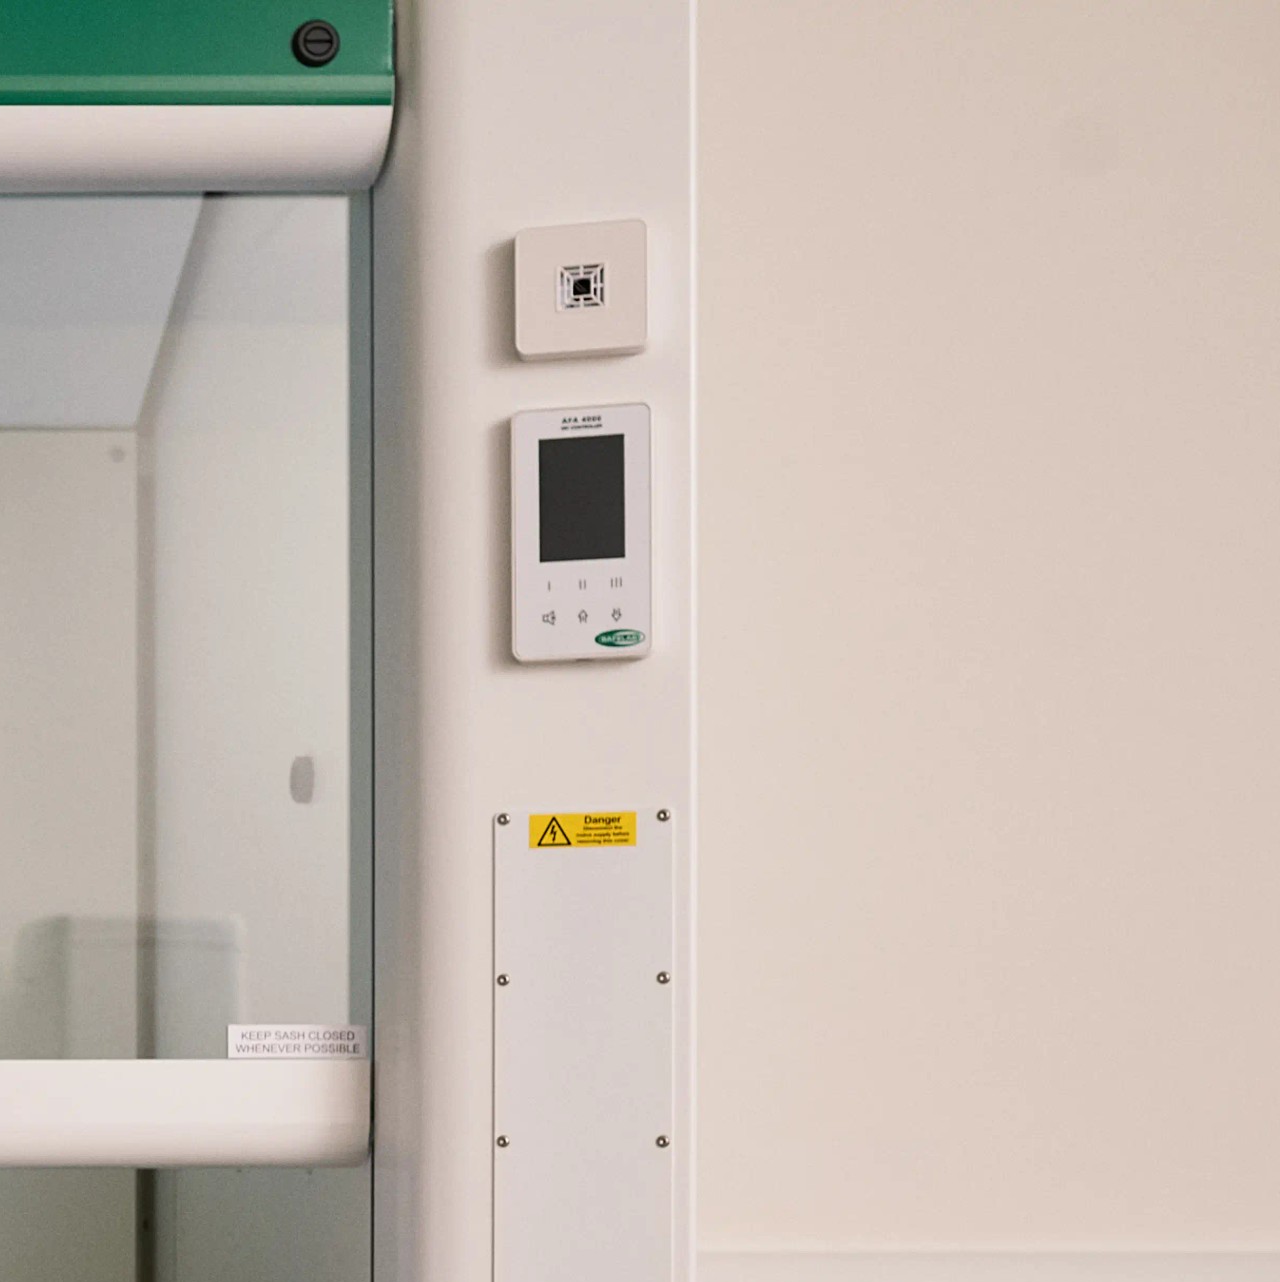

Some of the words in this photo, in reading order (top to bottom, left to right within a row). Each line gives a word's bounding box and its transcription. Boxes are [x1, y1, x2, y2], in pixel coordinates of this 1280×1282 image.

[584, 815, 621, 825] Danger
[241, 1031, 272, 1041] KEEP
[274, 1031, 305, 1041] SASH
[308, 1031, 355, 1041] CLOSED
[236, 1043, 300, 1053] WHENEVER
[304, 1043, 360, 1054] POSSIBLE
